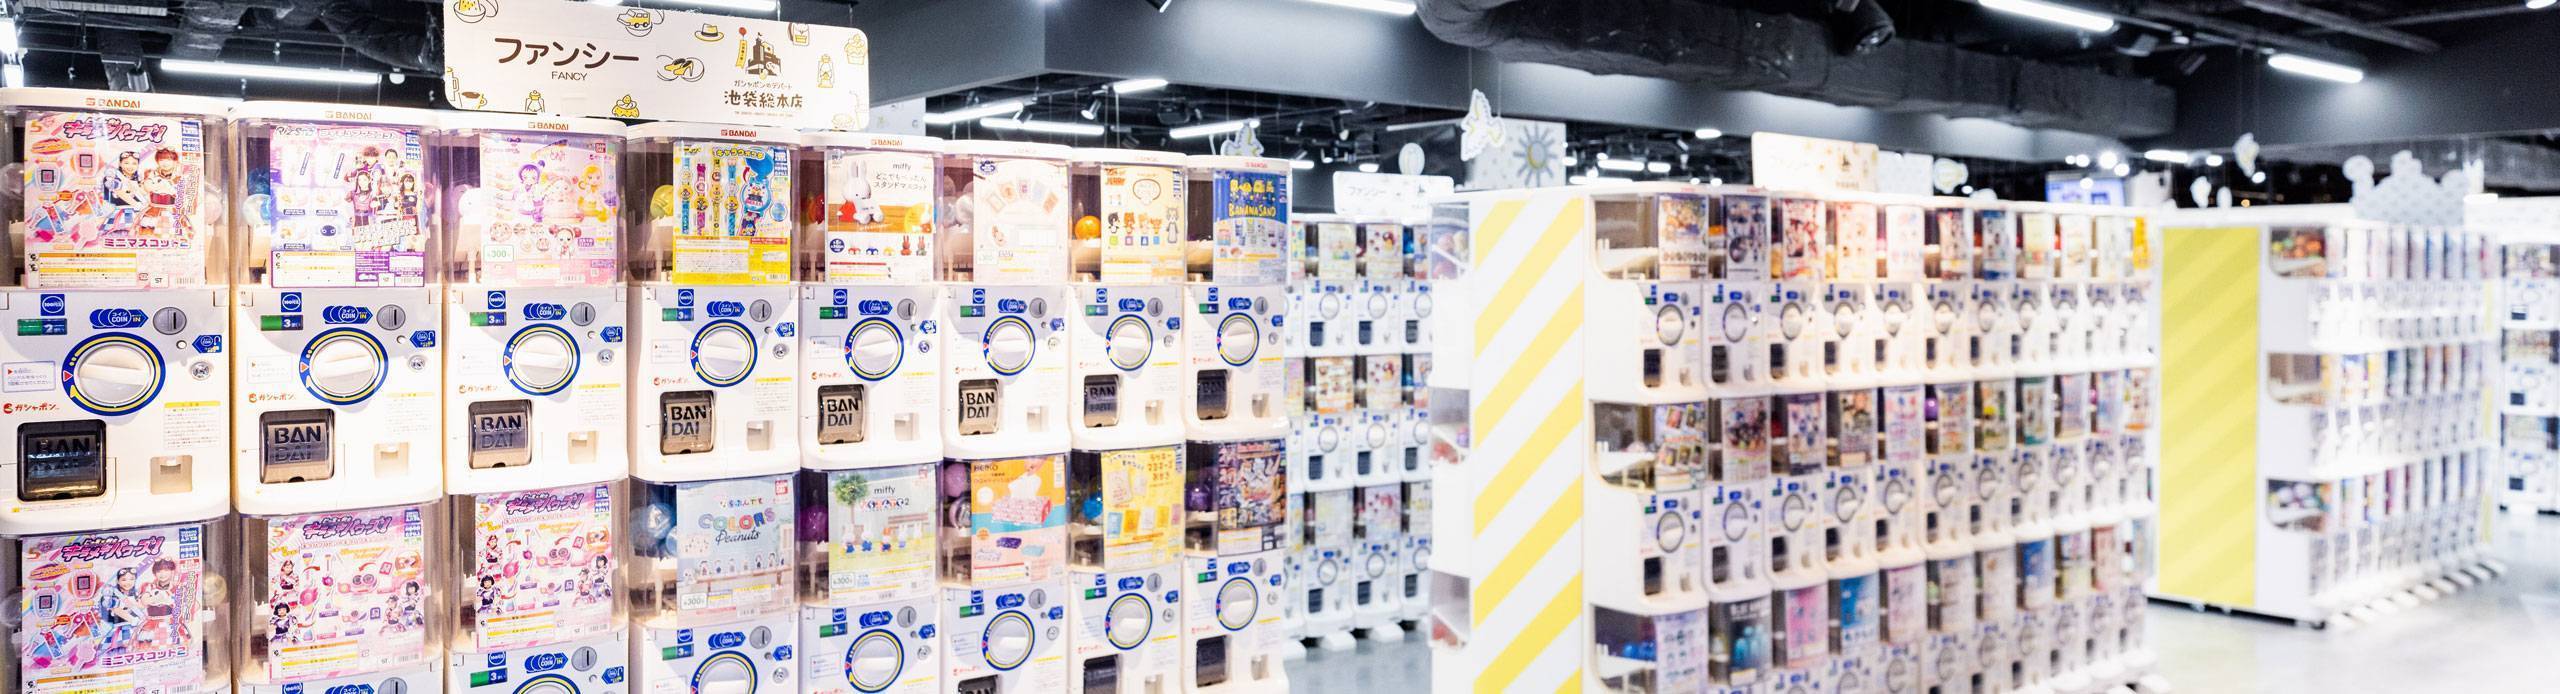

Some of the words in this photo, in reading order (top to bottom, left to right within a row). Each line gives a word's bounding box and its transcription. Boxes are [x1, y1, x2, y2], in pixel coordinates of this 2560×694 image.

[494, 37, 640, 70] ファンシー
[551, 70, 588, 82] FANCY
[724, 89, 804, 109] 池袋総本店
[335, 112, 372, 120] BANDAI
[537, 123, 569, 131] BANDAI
[729, 129, 757, 138] BANDAI
[892, 163, 912, 171] miffy
[259, 393, 295, 401] ガシャポン
[966, 391, 995, 405] BAN
[1090, 386, 1115, 399] BAN
[14, 402, 58, 412] ガシャポン
[827, 397, 859, 412] BAN
[967, 405, 990, 418] DAI
[671, 406, 708, 421] BAN
[827, 413, 853, 426] DAI
[481, 415, 521, 430] BAN
[671, 421, 700, 436] DAI
[274, 425, 321, 444] BAN
[481, 433, 513, 449] DAI
[274, 446, 313, 463] DAI
[874, 485, 896, 495] miffy
[698, 507, 776, 533] COLORS
[715, 527, 761, 545] Peanuts
[101, 646, 187, 668] ミニマスコット2
[541, 659, 555, 667] COIN
